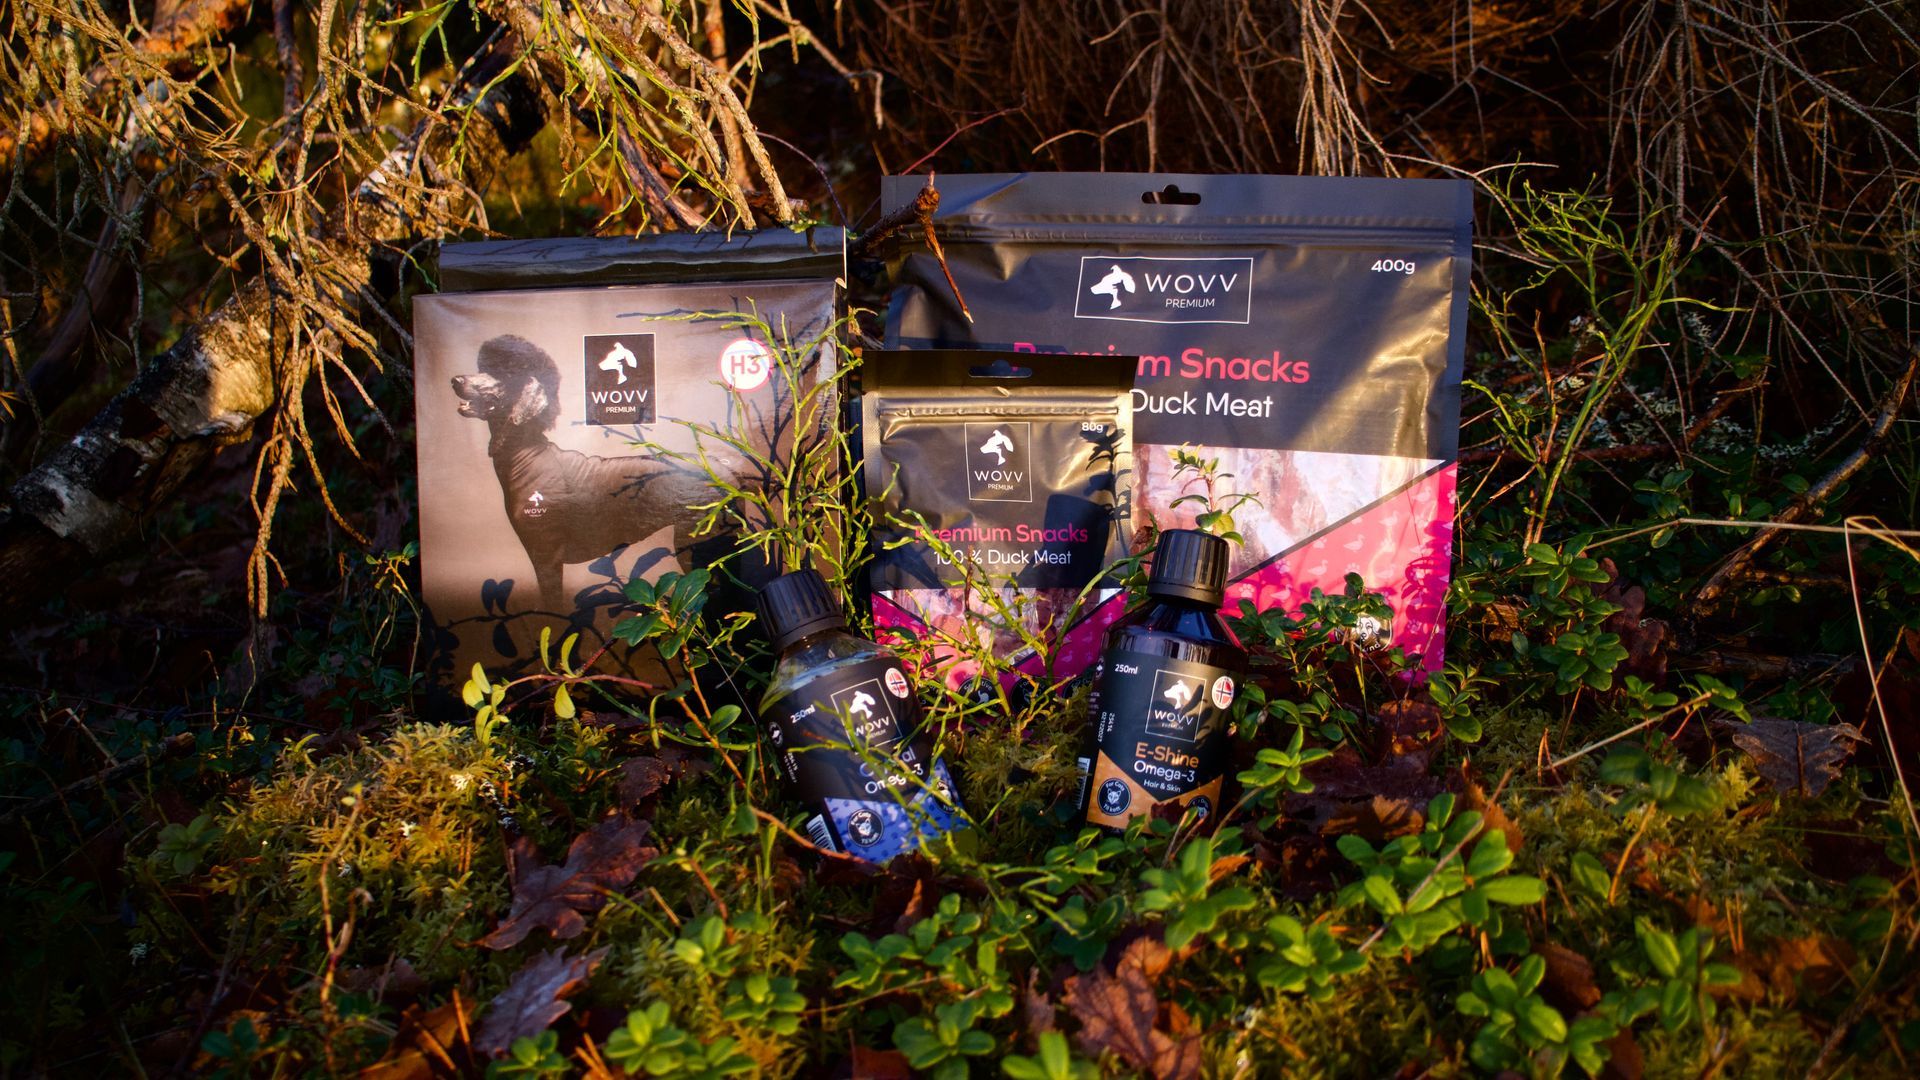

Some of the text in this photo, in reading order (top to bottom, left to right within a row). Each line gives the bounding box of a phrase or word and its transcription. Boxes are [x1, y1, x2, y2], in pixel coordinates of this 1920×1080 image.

[1371, 259, 1416, 275] 400g
[1144, 273, 1238, 294] WOVV
[1165, 298, 1216, 309] PREMIUM
[731, 355, 761, 375] H3
[1180, 348, 1311, 384] Snacks
[591, 390, 648, 404] WOVV
[1129, 388, 1274, 418] Duck Meat
[605, 406, 636, 414] PREMIUM
[1081, 422, 1104, 433] 80g
[974, 470, 1023, 483] WOVV
[987, 483, 1014, 491] PREMIUM
[1016, 523, 1088, 543] Snacks
[988, 549, 1030, 565] Duck
[1034, 550, 1072, 565] Meat
[1114, 663, 1139, 675] 250ml
[790, 704, 816, 724] 250ml
[1154, 709, 1194, 726] WOVV
[1135, 742, 1199, 768] E-Shine
[865, 763, 924, 794] Omeg-3
[1134, 760, 1195, 783] Omega-3
[1143, 779, 1160, 788] Hair
[1167, 783, 1181, 793] Skin
